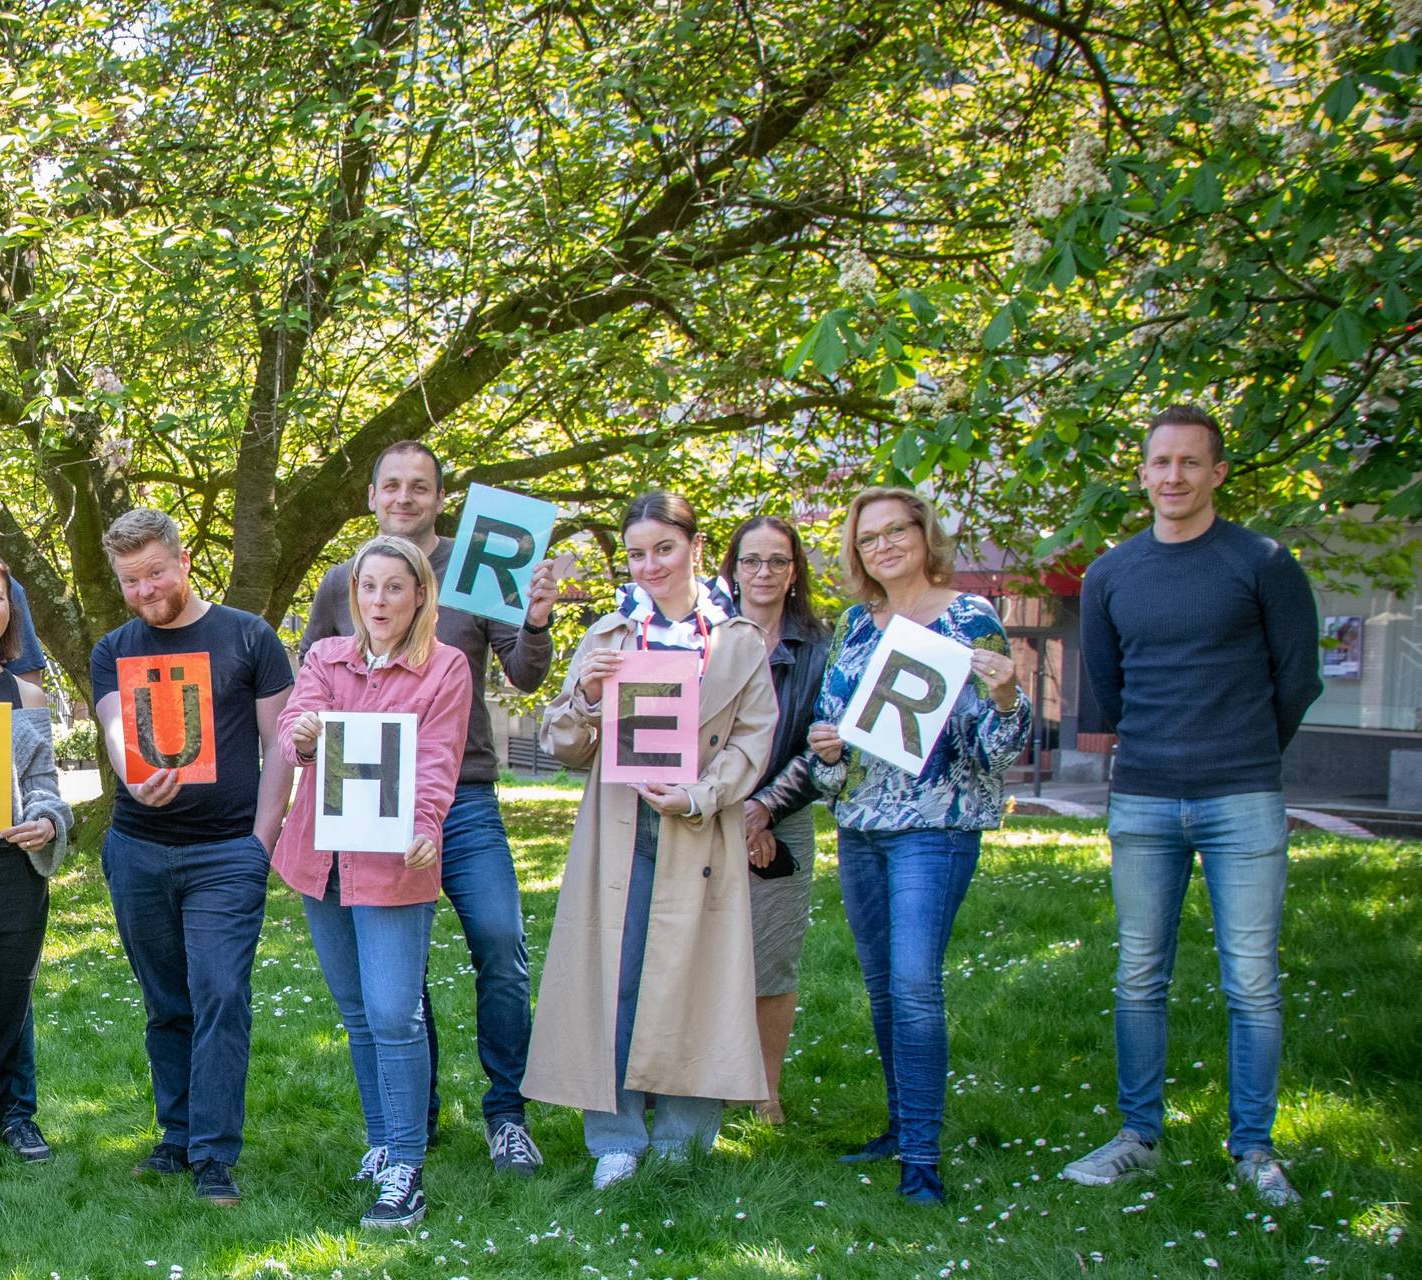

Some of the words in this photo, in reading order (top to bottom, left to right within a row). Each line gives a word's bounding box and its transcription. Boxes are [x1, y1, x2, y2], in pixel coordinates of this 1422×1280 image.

[455, 515, 535, 610] R
[134, 666, 202, 769] Ü
[617, 682, 682, 767] E
[856, 650, 946, 759] R
[323, 721, 401, 817] H
